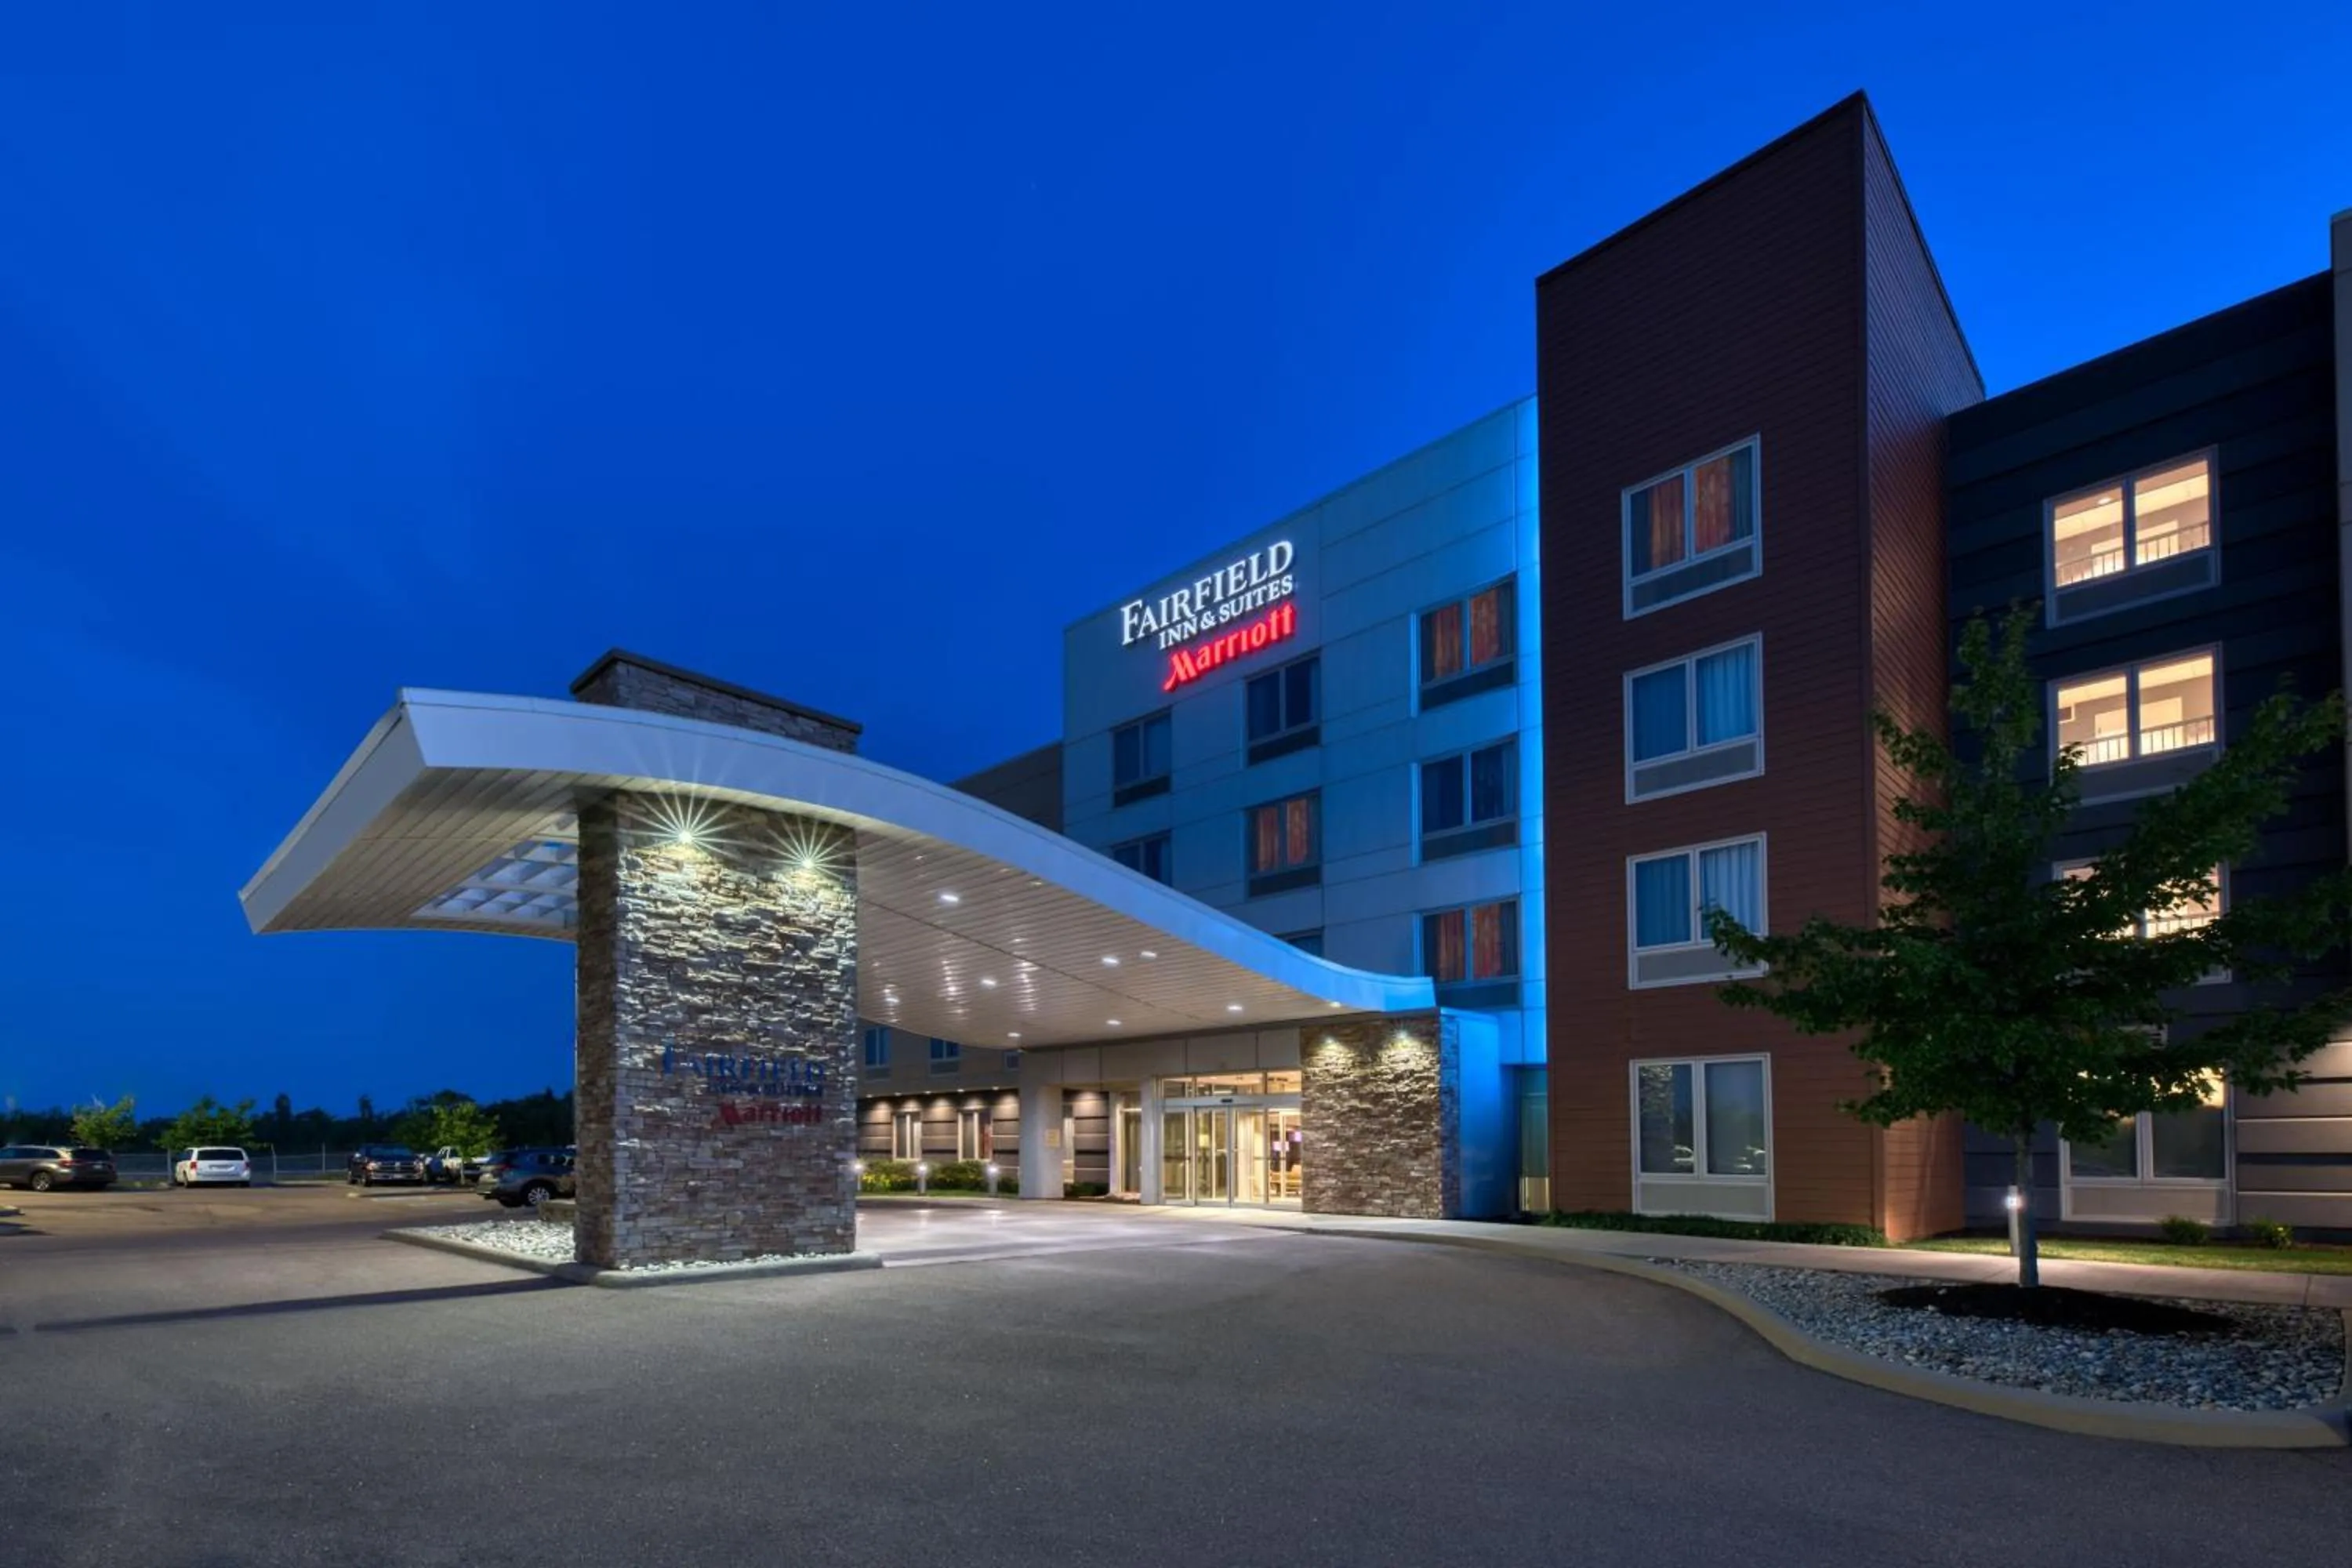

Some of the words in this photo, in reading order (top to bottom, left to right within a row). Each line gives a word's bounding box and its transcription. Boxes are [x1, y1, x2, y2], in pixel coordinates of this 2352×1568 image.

[1120, 540, 1294, 646] FAIRFIELD
[1159, 617, 1197, 650] INN
[1218, 574, 1294, 623] SUITES
[1163, 603, 1296, 691] Marriott
